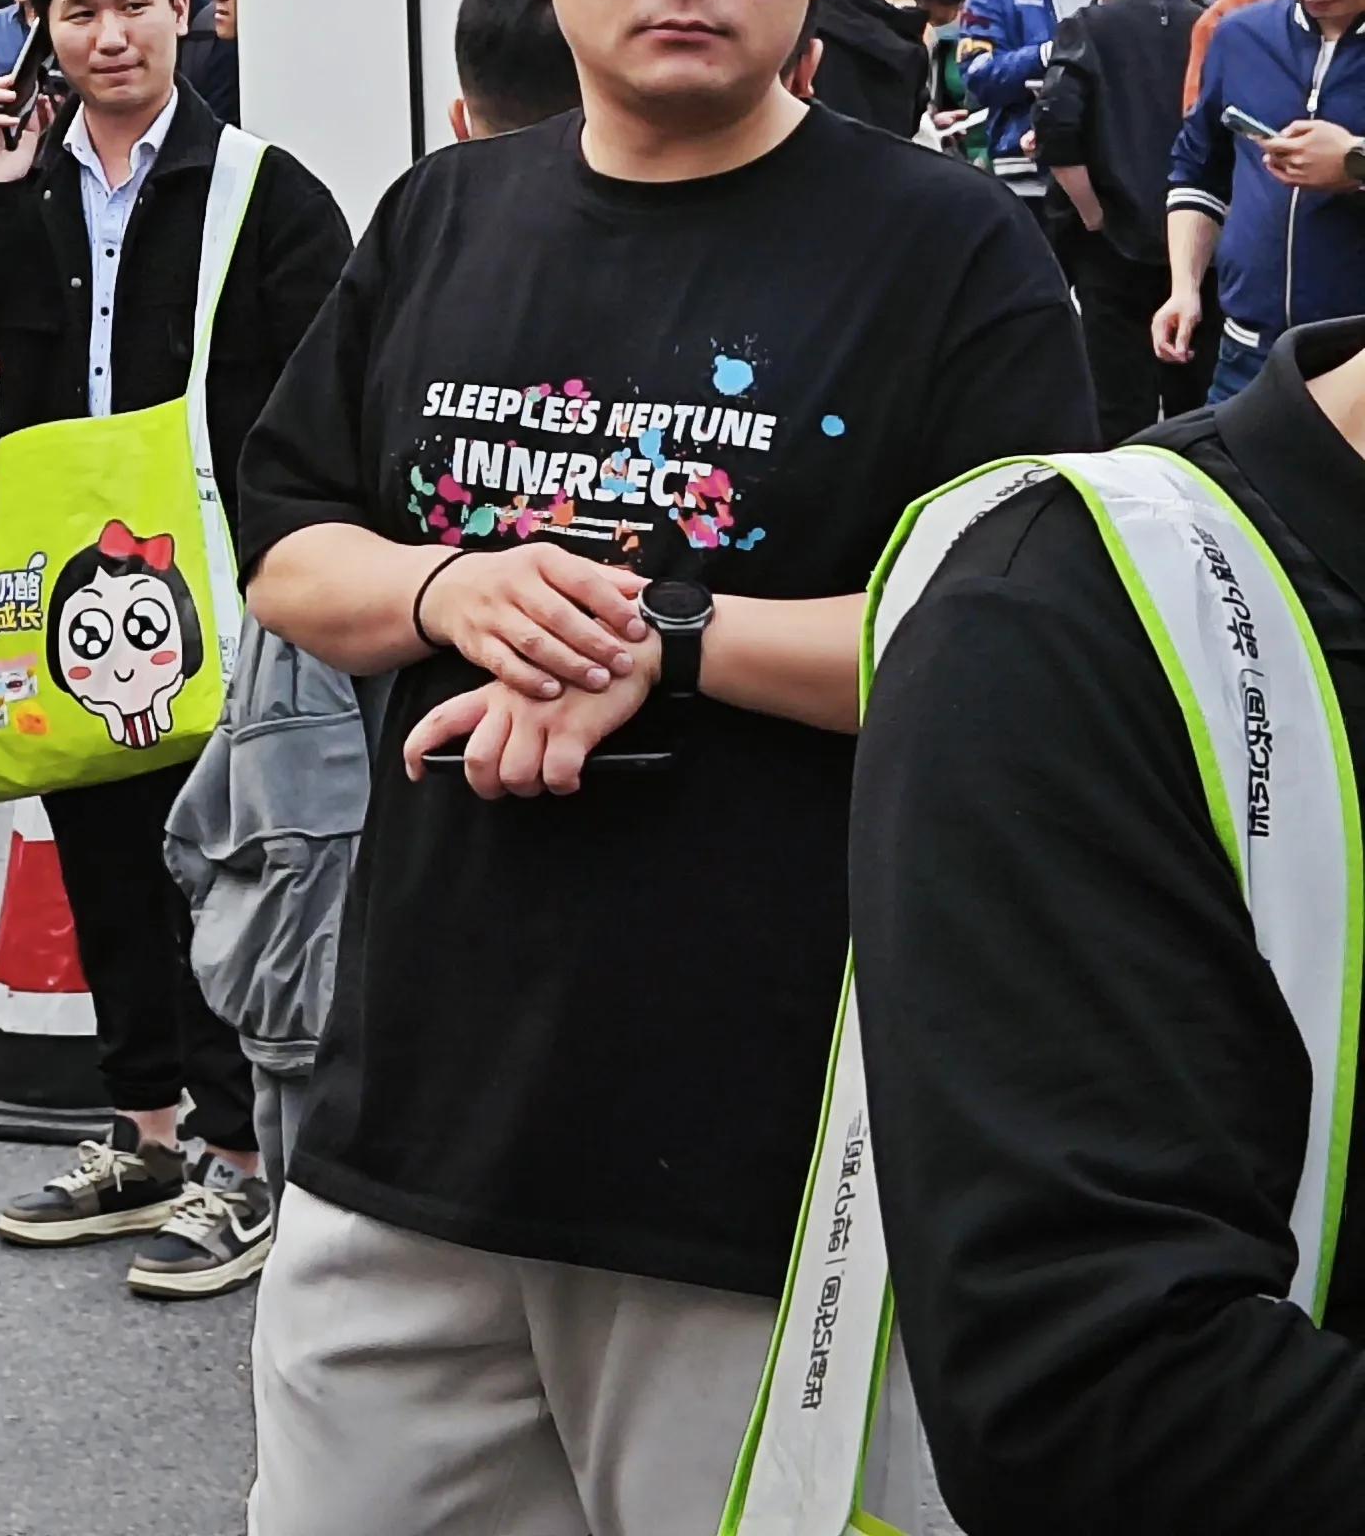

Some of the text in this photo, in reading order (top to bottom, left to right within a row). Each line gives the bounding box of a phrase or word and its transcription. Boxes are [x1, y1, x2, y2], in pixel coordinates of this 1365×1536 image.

[423, 381, 777, 452] SLEEPLESS NEPTUNE
[451, 437, 713, 509] INNERSECT
